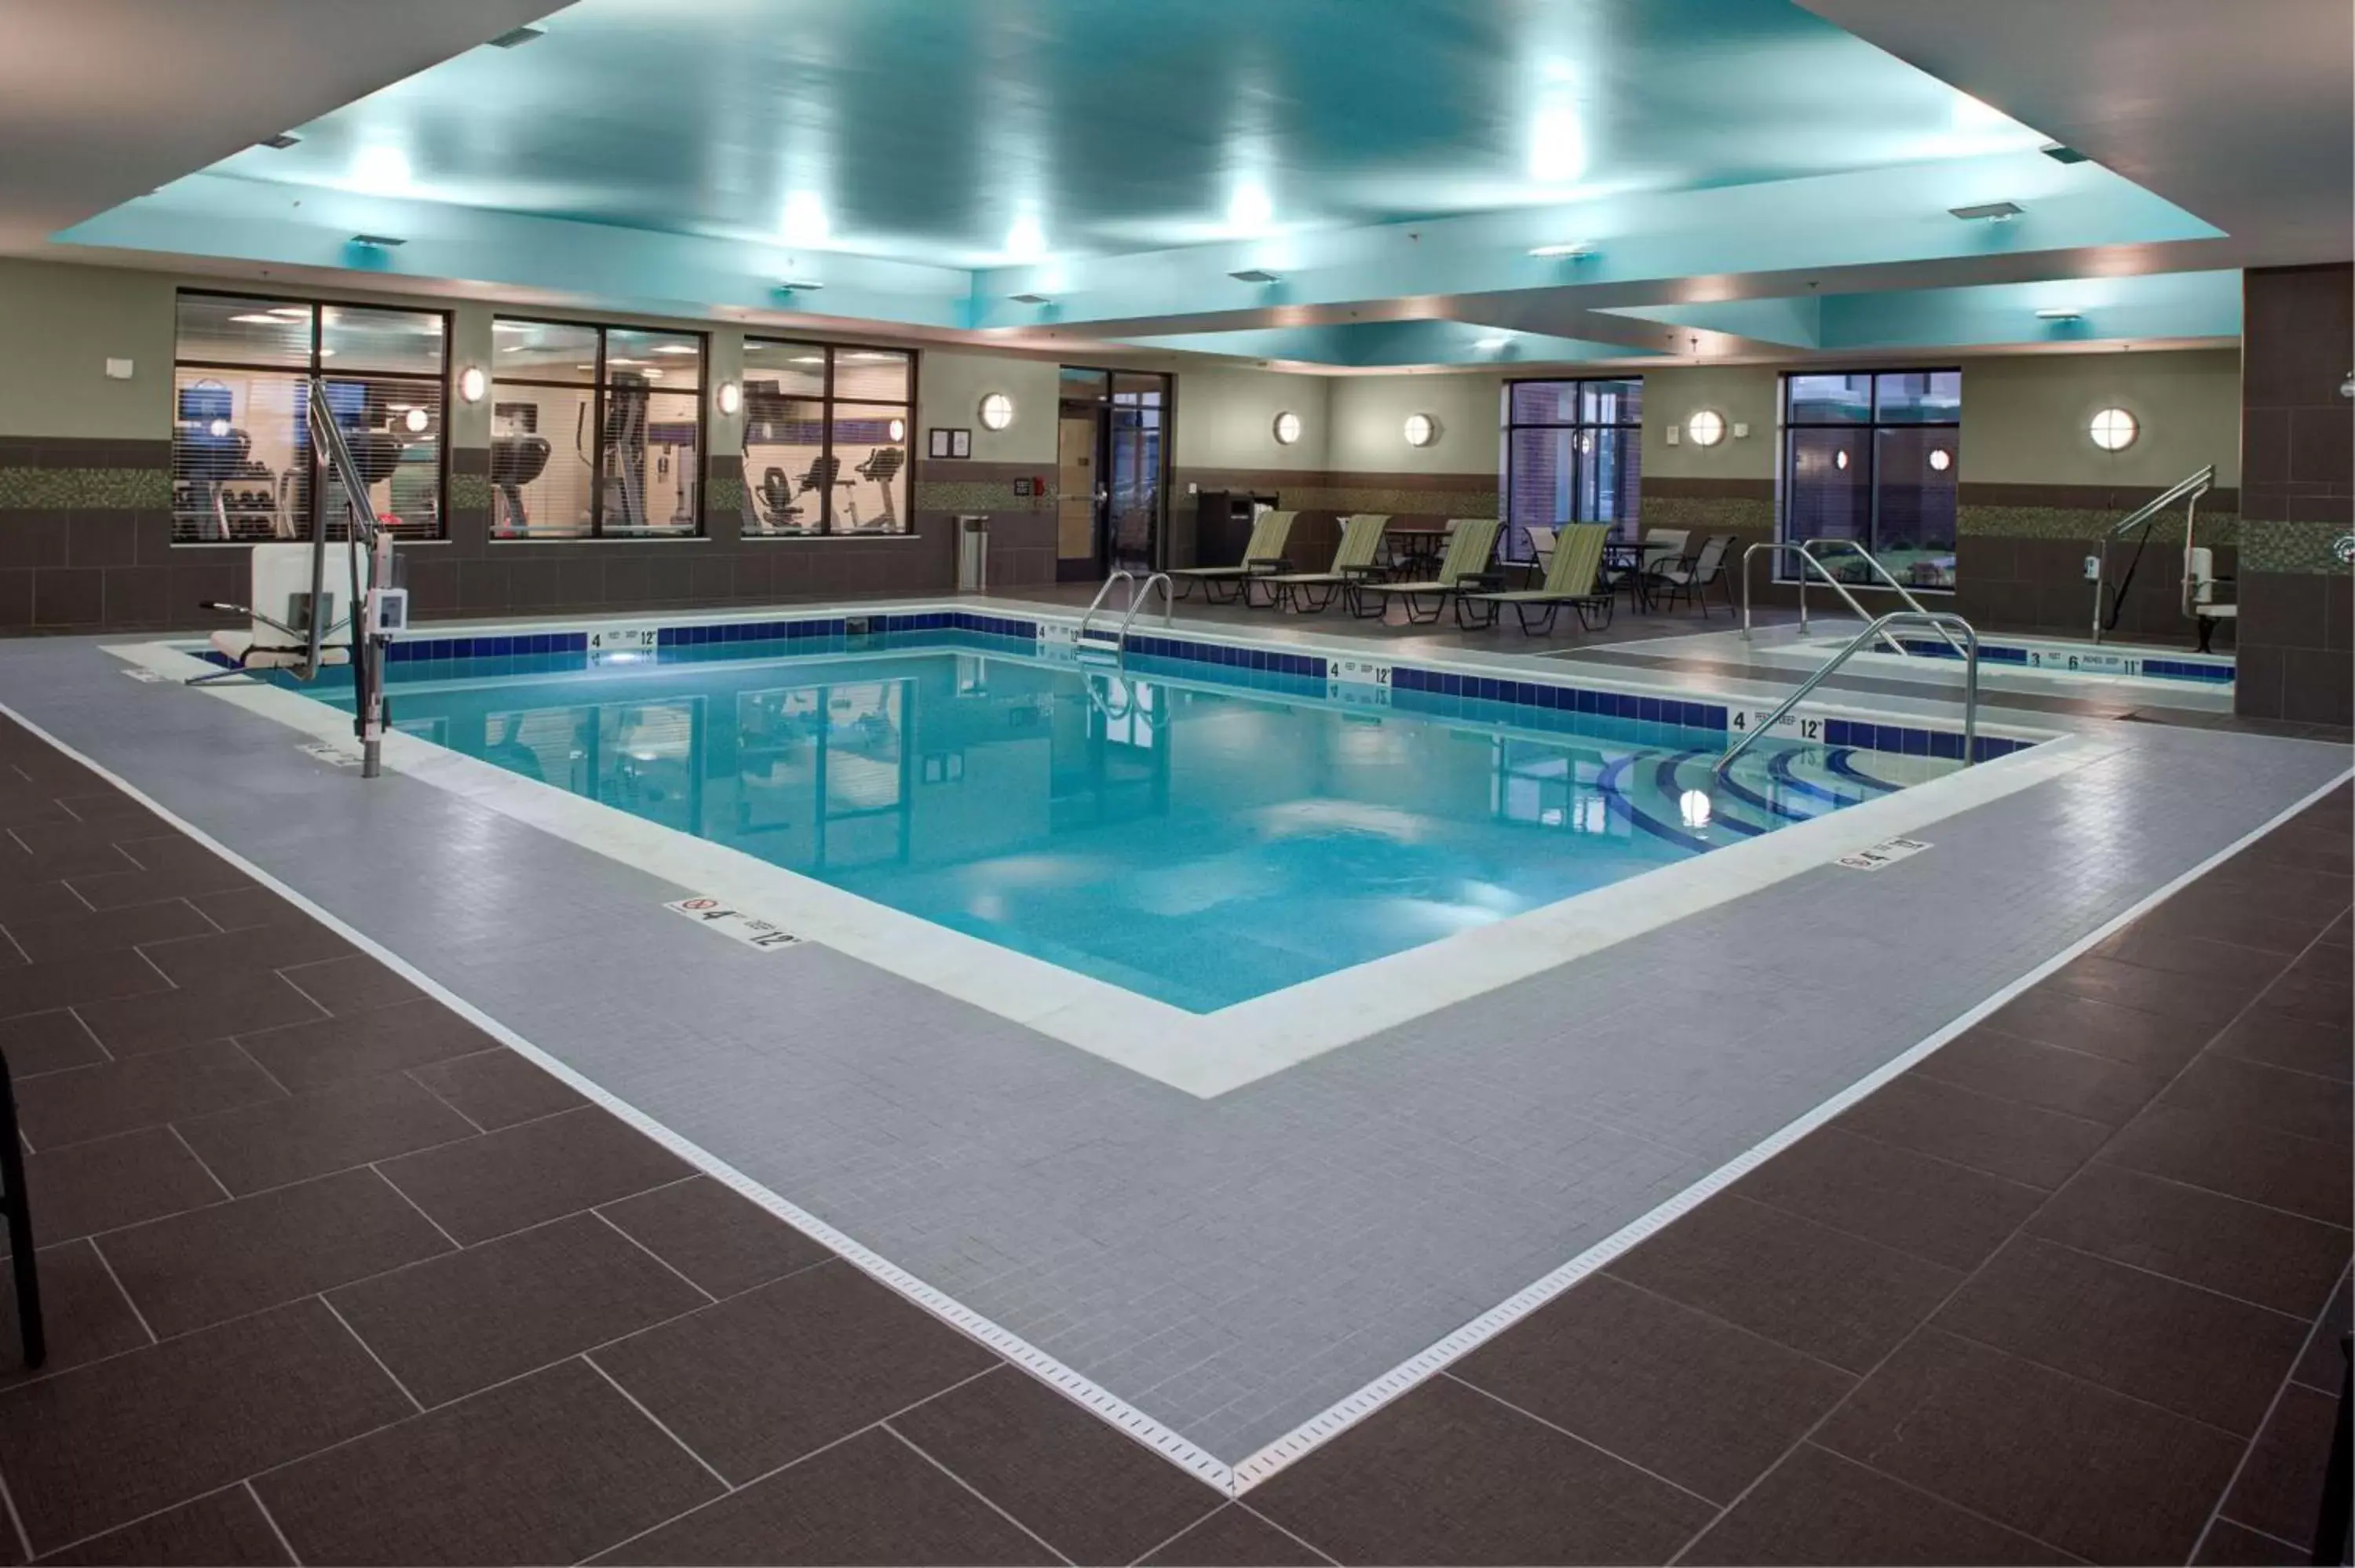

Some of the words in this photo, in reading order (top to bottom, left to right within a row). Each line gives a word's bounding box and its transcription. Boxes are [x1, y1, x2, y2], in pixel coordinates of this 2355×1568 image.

[592, 633, 600, 647] 4
[2032, 652, 2040, 667] 3
[2068, 655, 2079, 670] 6
[1331, 662, 1338, 676] 4
[1733, 712, 1745, 730] 4
[703, 910, 736, 921] 4
